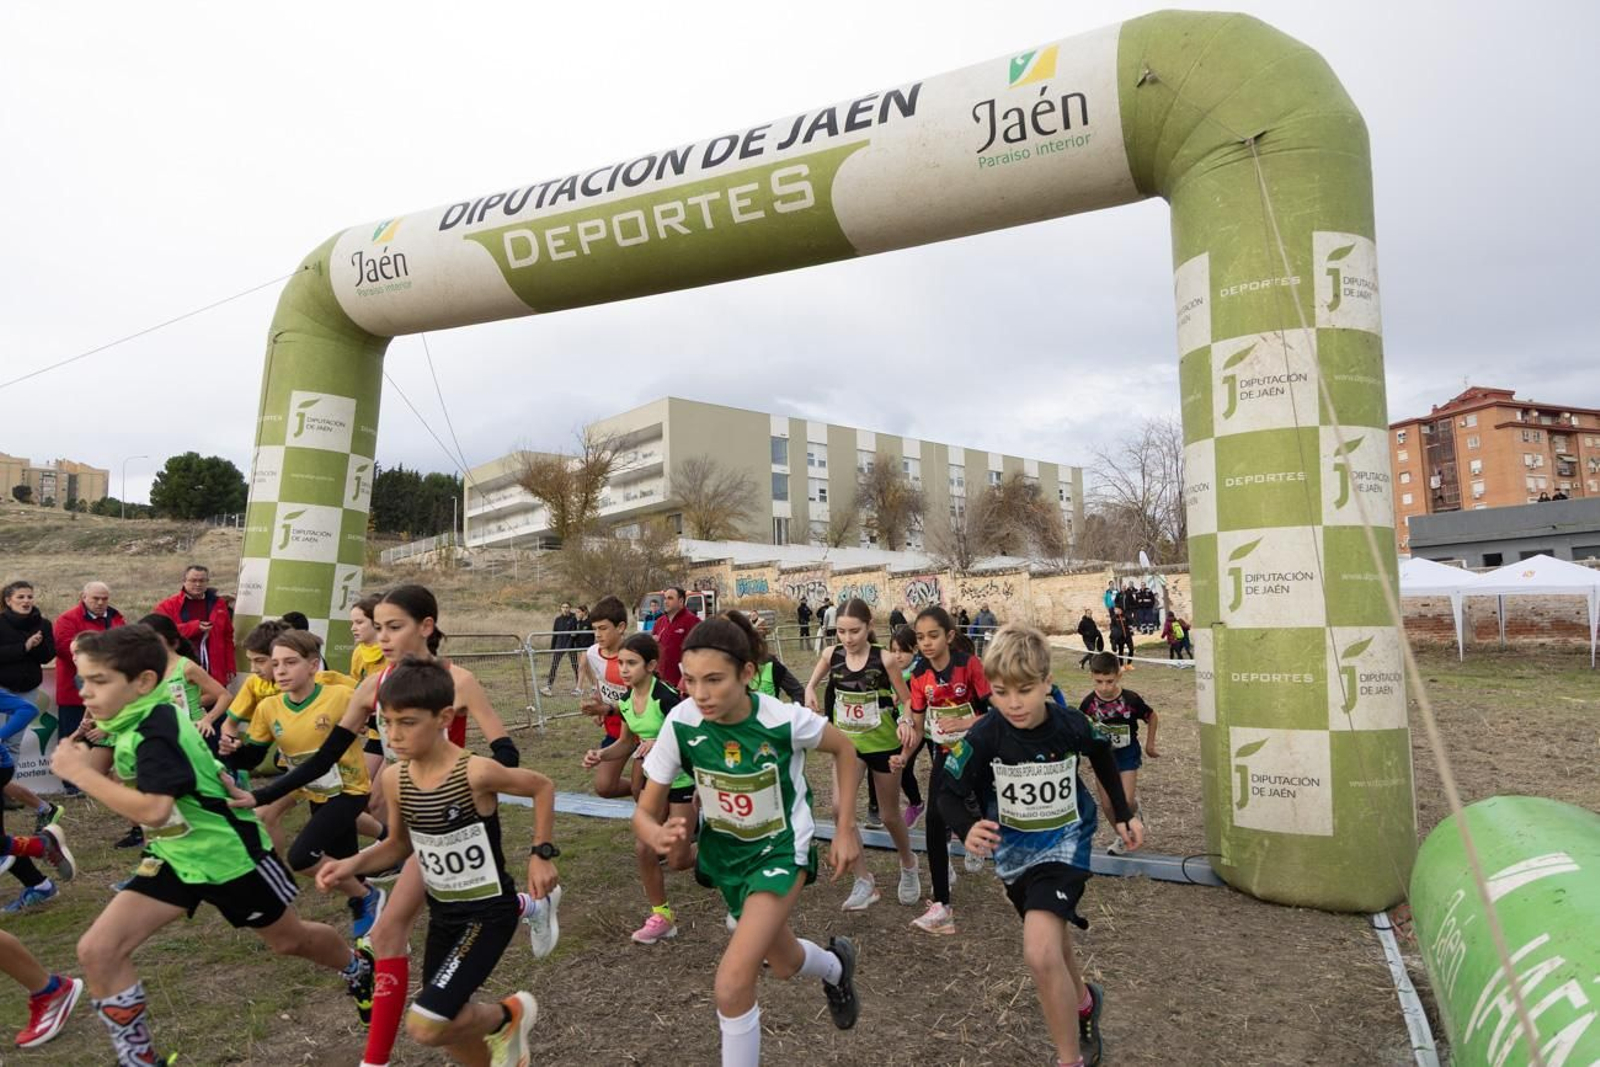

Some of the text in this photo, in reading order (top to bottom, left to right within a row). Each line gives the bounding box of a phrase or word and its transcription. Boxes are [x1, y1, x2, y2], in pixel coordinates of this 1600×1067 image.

[971, 85, 1089, 154] Jaén
[701, 124, 772, 169] DE
[1035, 133, 1092, 156] interior
[503, 164, 815, 269] DEPORTES
[351, 246, 409, 288] Jaén
[1220, 276, 1301, 298] DEPORTES
[1240, 373, 1308, 389] DIPUTACIÓN
[1240, 386, 1285, 400] DE JAÉN
[1225, 471, 1307, 487] DEPORTES
[1245, 571, 1314, 583] DIPUTACIÓN
[1245, 584, 1290, 595] DE JAÉN
[1231, 672, 1314, 684] DEPORTES
[1360, 686, 1374, 695] DE
[843, 703, 865, 719] 76
[1251, 774, 1320, 787] DIPUTACIÓN
[1002, 776, 1071, 805] 4308
[1252, 786, 1296, 798] DE JAÉN
[718, 792, 753, 817] 59
